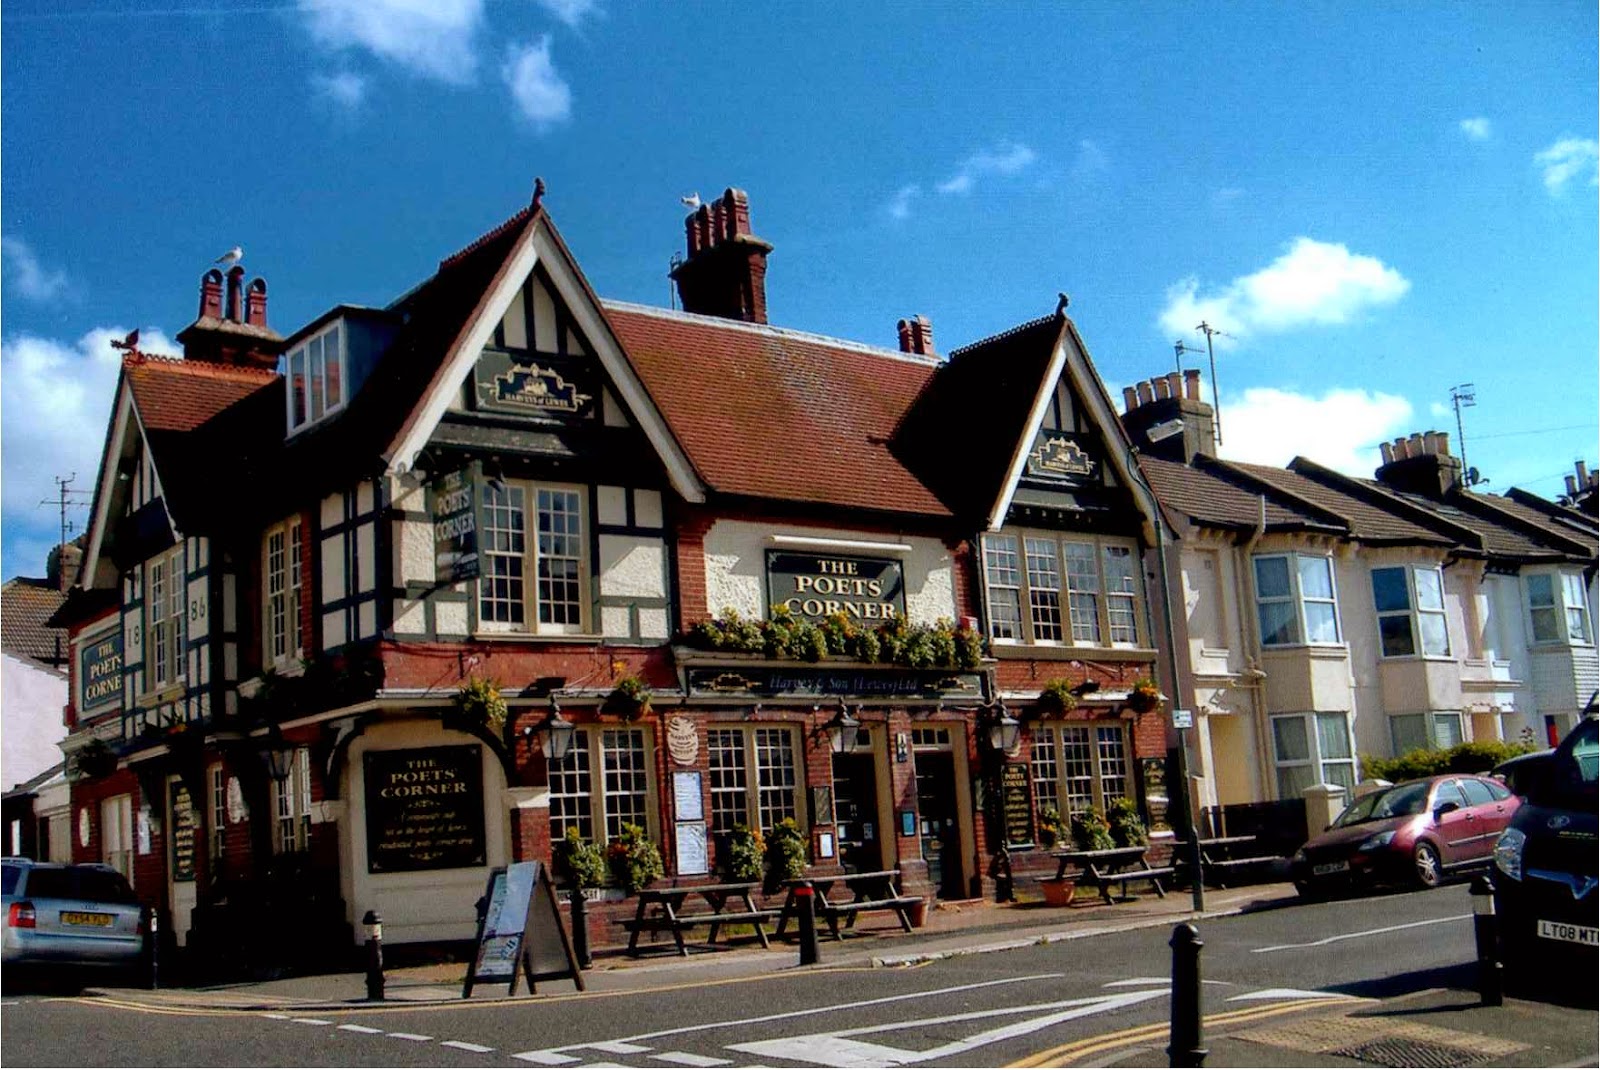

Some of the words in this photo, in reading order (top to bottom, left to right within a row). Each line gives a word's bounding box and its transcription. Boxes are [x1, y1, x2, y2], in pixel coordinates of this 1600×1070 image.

[435, 512, 475, 542] CORNER
[817, 560, 859, 576] THE
[784, 598, 897, 620] CORNER
[86, 674, 122, 700] CORNE
[407, 759, 436, 769] THE
[380, 782, 467, 797] CORNER
[1542, 922, 1576, 940] LT08
[1579, 929, 1599, 944] MT
